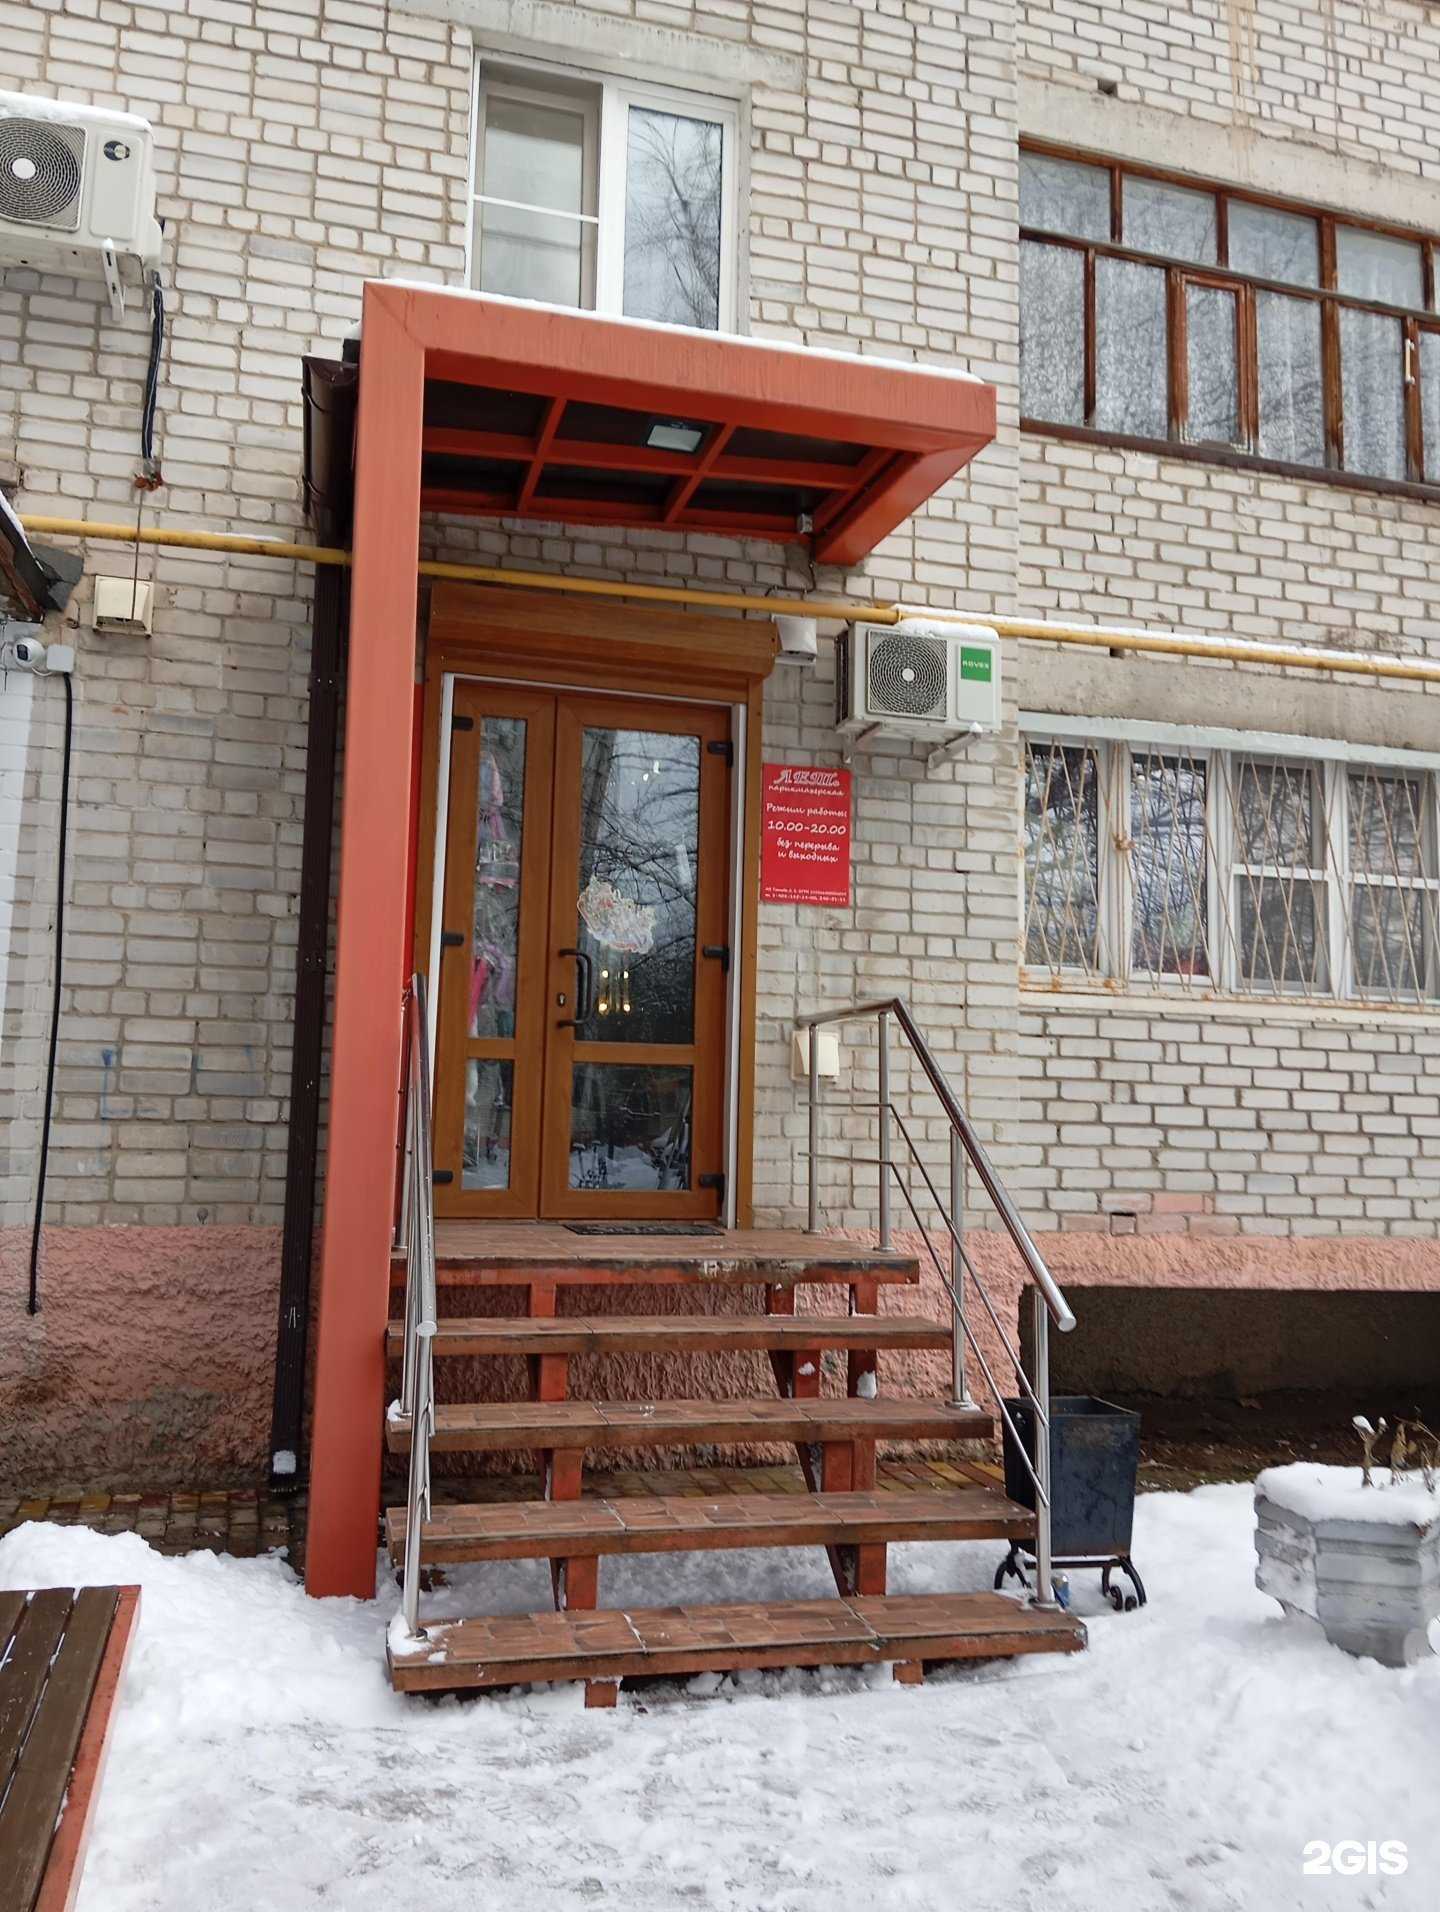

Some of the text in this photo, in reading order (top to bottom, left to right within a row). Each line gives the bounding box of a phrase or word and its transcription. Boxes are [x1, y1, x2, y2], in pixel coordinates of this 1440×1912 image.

[768, 785, 844, 796] парикмахерская
[766, 802, 805, 812] Режим
[768, 820, 847, 835] 10.00-20.00
[776, 837, 841, 852] без перерыва
[777, 850, 839, 863] и выходных
